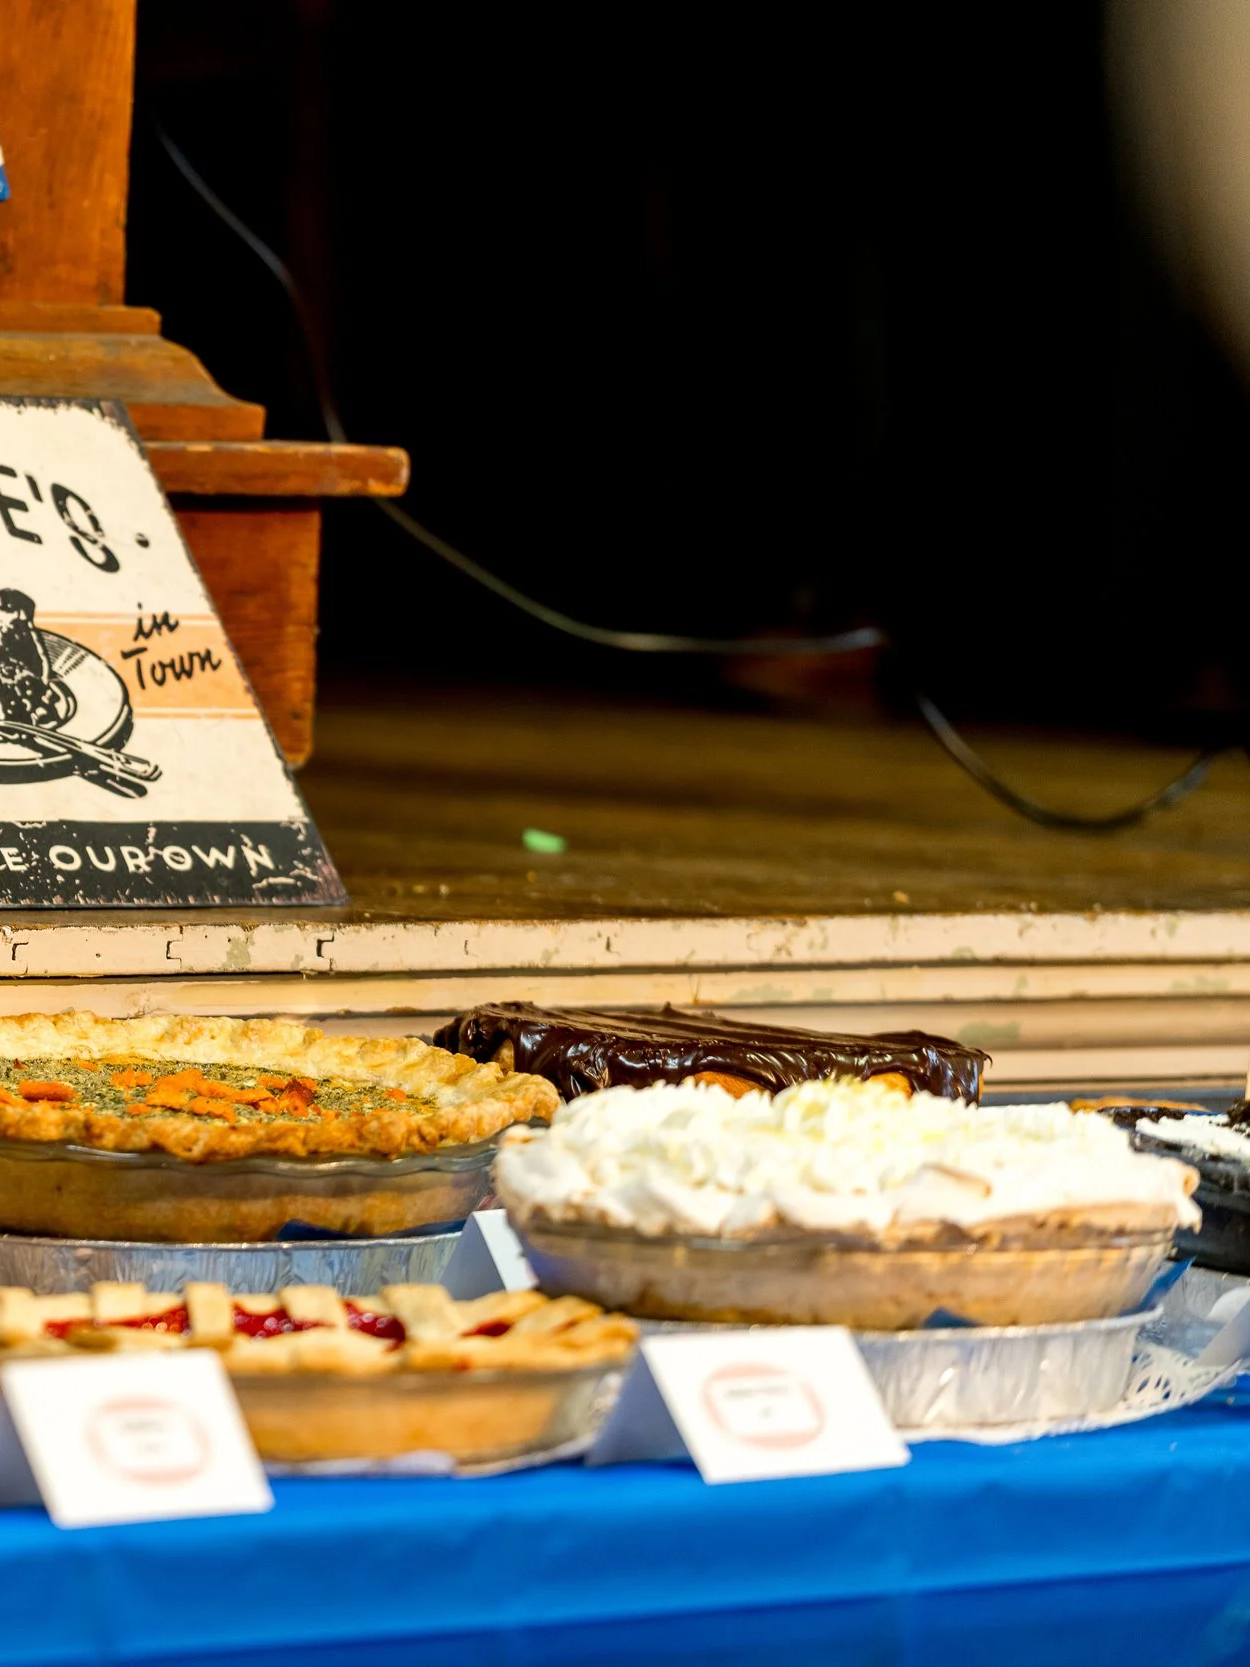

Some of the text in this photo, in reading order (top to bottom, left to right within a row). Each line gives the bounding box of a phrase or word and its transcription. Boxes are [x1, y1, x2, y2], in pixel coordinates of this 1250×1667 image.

[133, 602, 180, 642] in
[120, 647, 222, 690] Town
[49, 845, 151, 873] OUR
[162, 845, 275, 877] OWN
